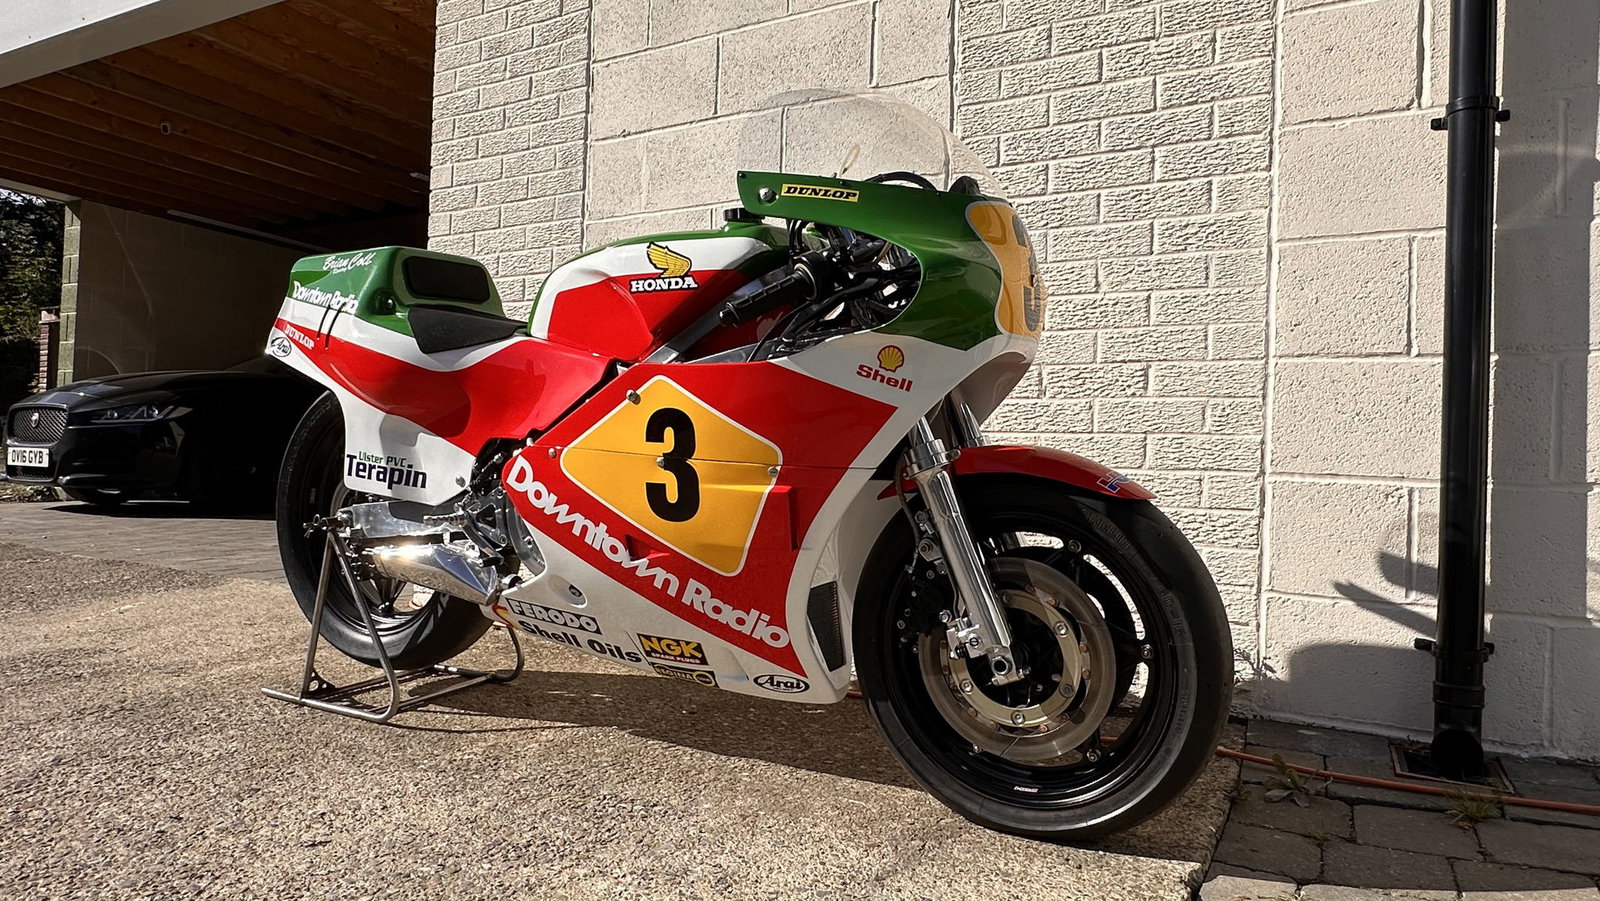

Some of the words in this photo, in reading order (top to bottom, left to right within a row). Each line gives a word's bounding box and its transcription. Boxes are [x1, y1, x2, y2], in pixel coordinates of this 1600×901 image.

[783, 185, 858, 200] DUNLOP
[322, 255, 350, 270] Brian
[347, 252, 376, 270] Coll
[292, 280, 331, 309] Downtown
[630, 276, 698, 293] HONDA
[284, 323, 315, 350] DUNLOP
[856, 364, 912, 392] Shell
[28, 450, 44, 464] GYB
[358, 451, 384, 464] Ulster
[386, 456, 407, 468] PVC
[645, 407, 700, 523] 3
[346, 454, 428, 490] Terapin
[506, 454, 680, 597] Downtown
[681, 578, 789, 648] Radio
[508, 599, 599, 633] FERODO
[517, 619, 583, 648] Shell
[587, 638, 643, 664] Oils
[640, 635, 702, 658] NGK
[651, 653, 675, 661] SPARK
[675, 656, 701, 664] PLUGS
[758, 675, 804, 690] Arai
